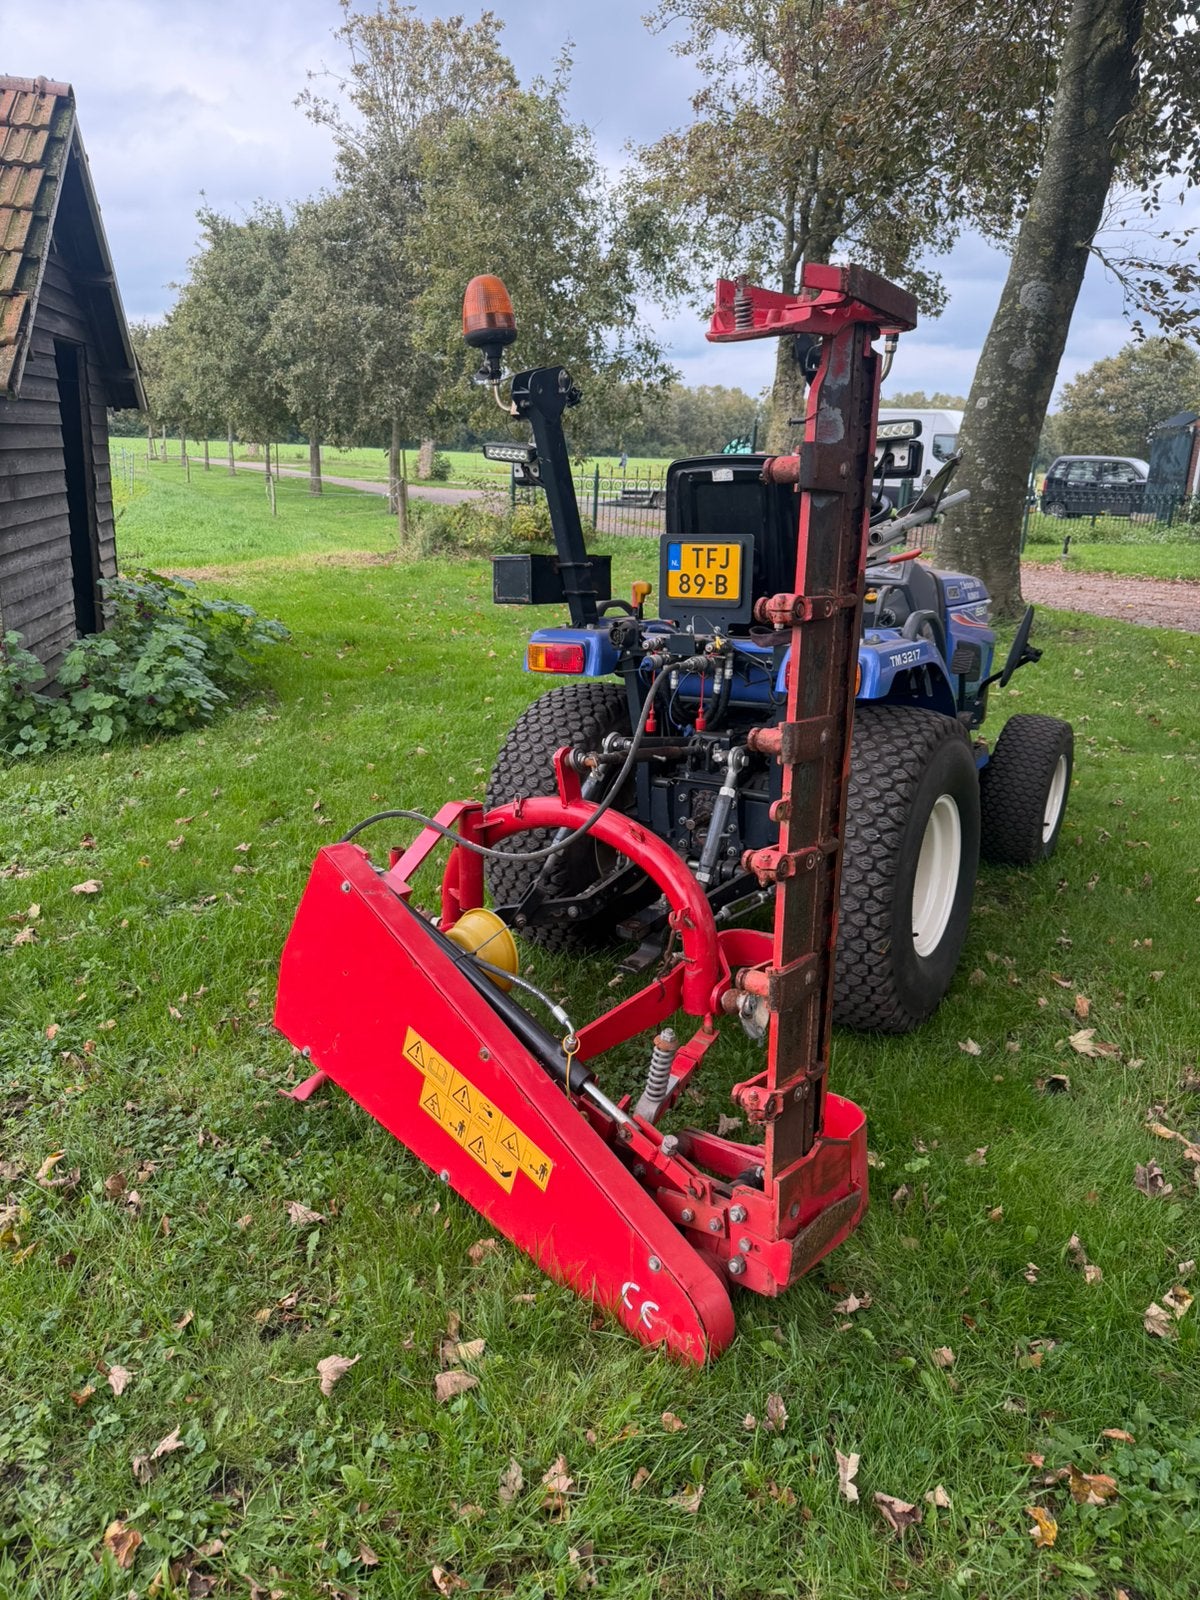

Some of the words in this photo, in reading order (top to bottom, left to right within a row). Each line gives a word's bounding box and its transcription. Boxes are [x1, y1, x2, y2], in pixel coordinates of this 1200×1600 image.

[671, 559, 679, 567] NL
[692, 547, 730, 569] TFJ
[678, 573, 728, 595] 89-B
[621, 1281, 660, 1329] CE
